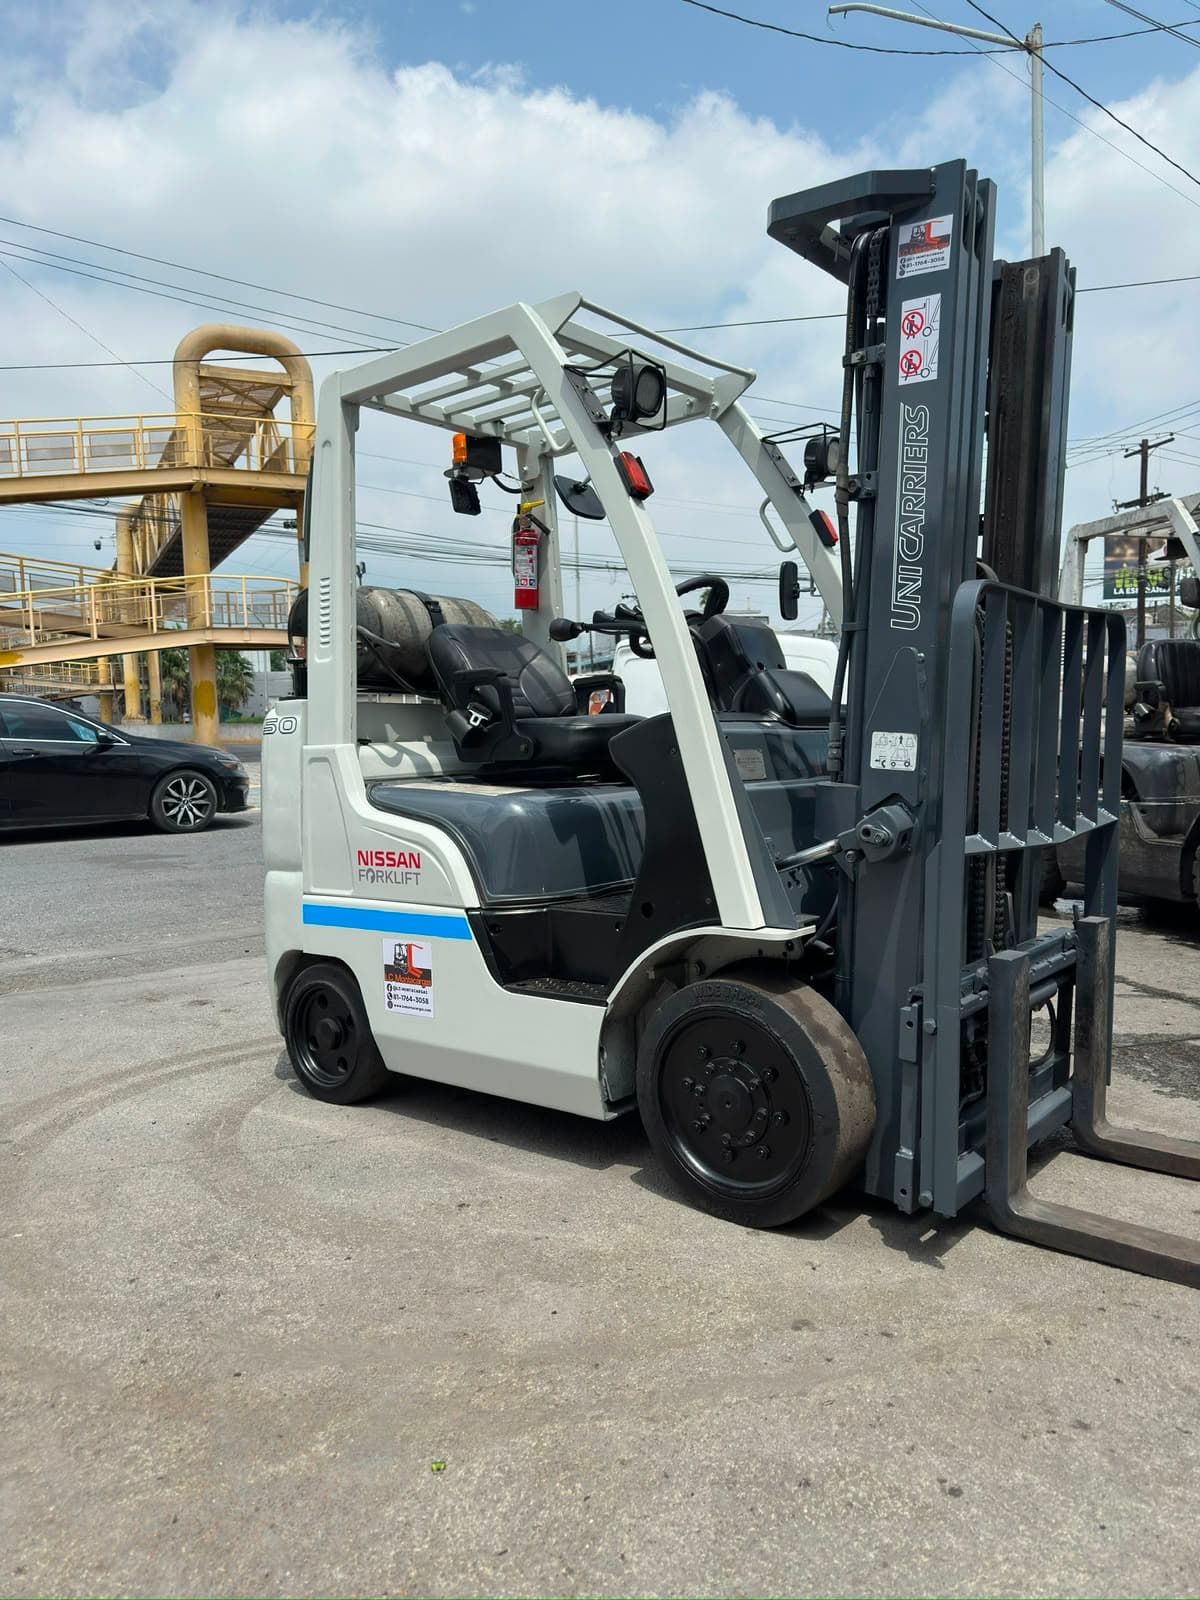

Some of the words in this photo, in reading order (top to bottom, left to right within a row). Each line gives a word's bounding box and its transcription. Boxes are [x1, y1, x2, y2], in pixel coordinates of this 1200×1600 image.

[890, 402, 930, 631] UNICARRIERS
[357, 850, 420, 869] NISSAN
[358, 868, 421, 886] FORKLIFT
[393, 993, 429, 1005] 81-1764-3058
